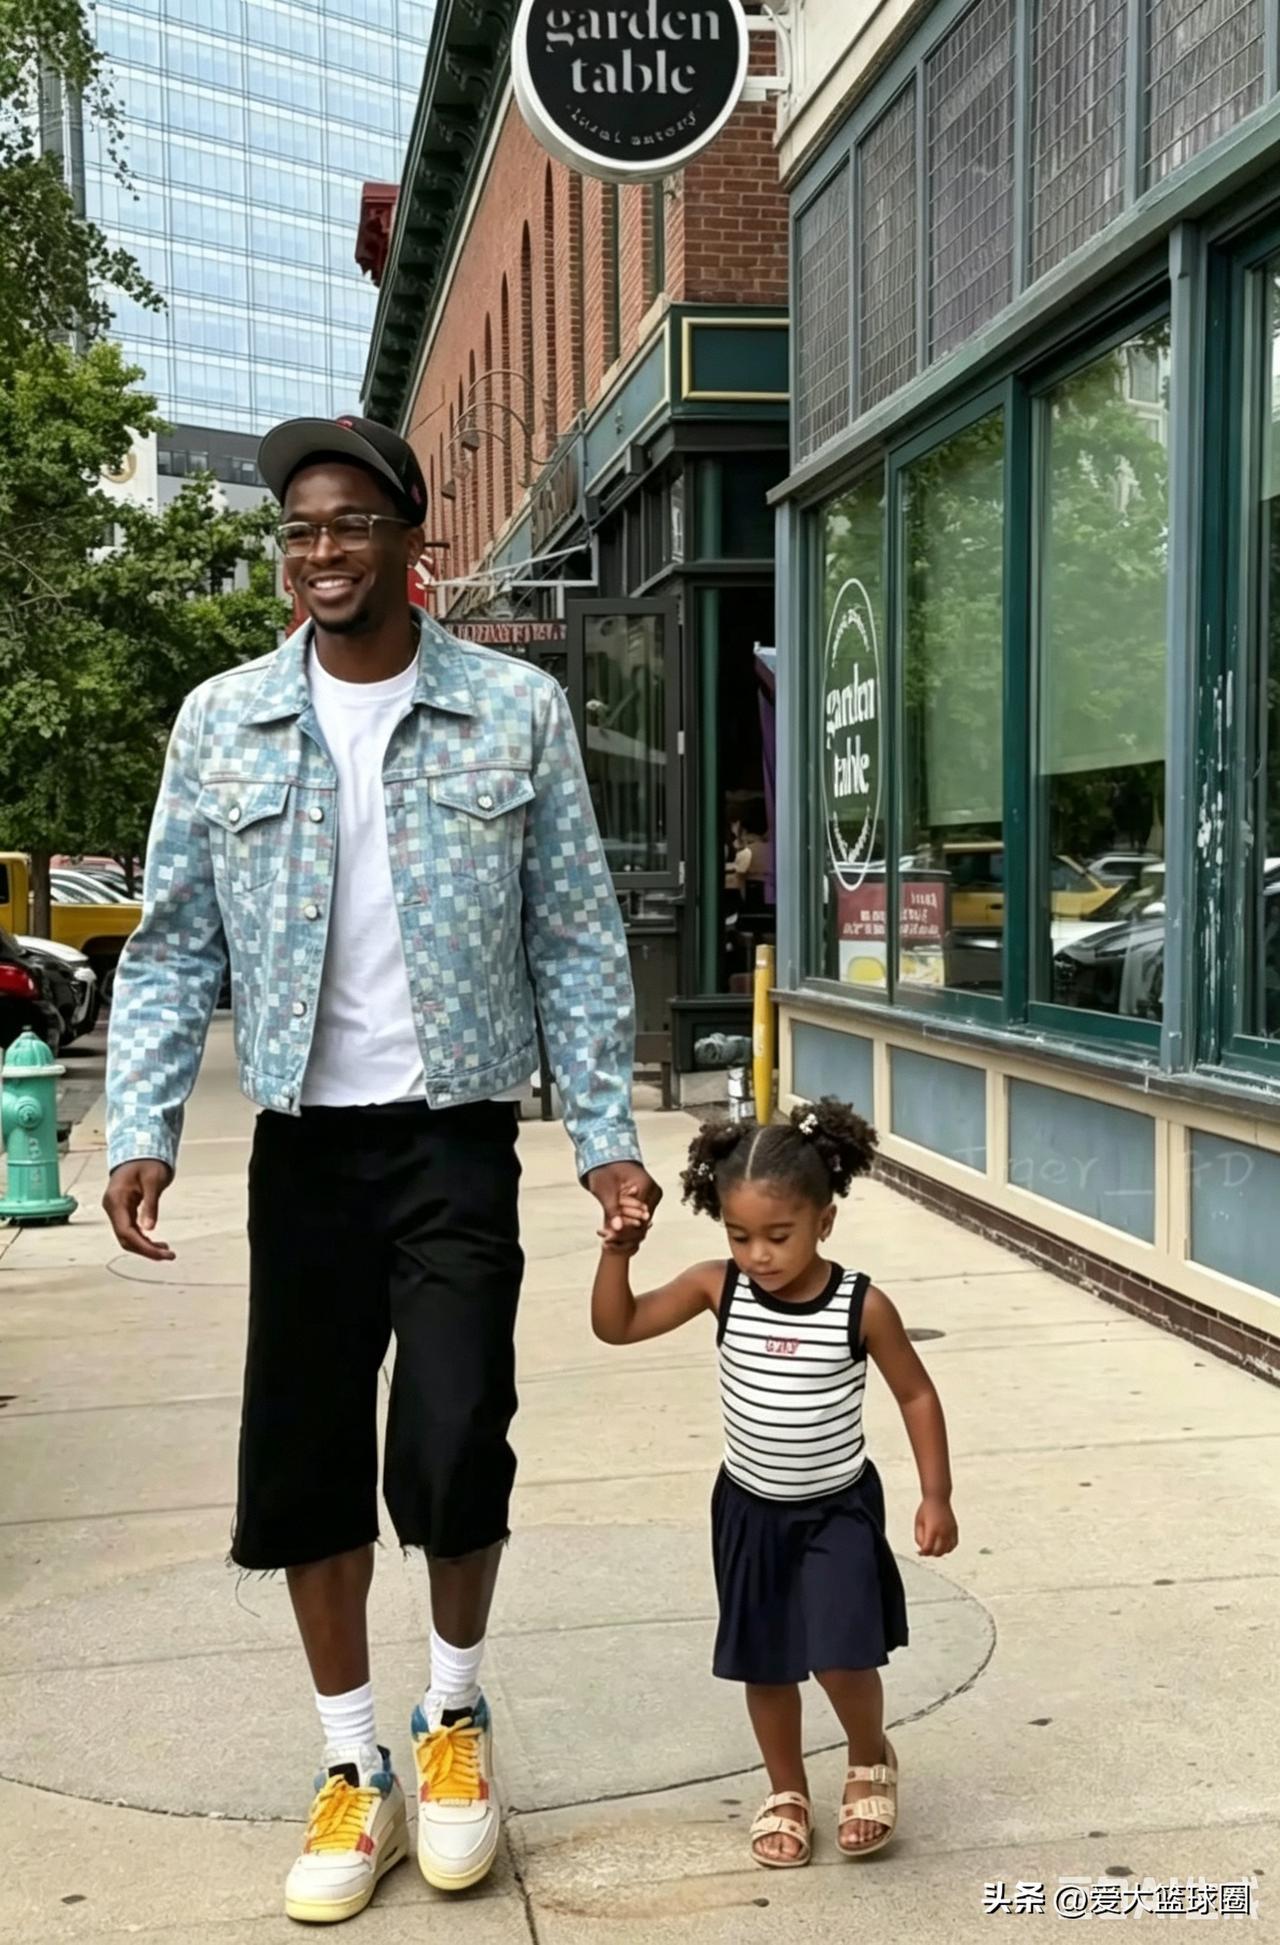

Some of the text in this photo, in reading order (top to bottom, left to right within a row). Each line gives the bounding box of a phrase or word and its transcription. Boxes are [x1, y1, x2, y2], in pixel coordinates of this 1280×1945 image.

[546, 0, 720, 53] garden
[571, 49, 696, 94] table
[826, 662, 876, 750] garden
[834, 734, 870, 798] table
